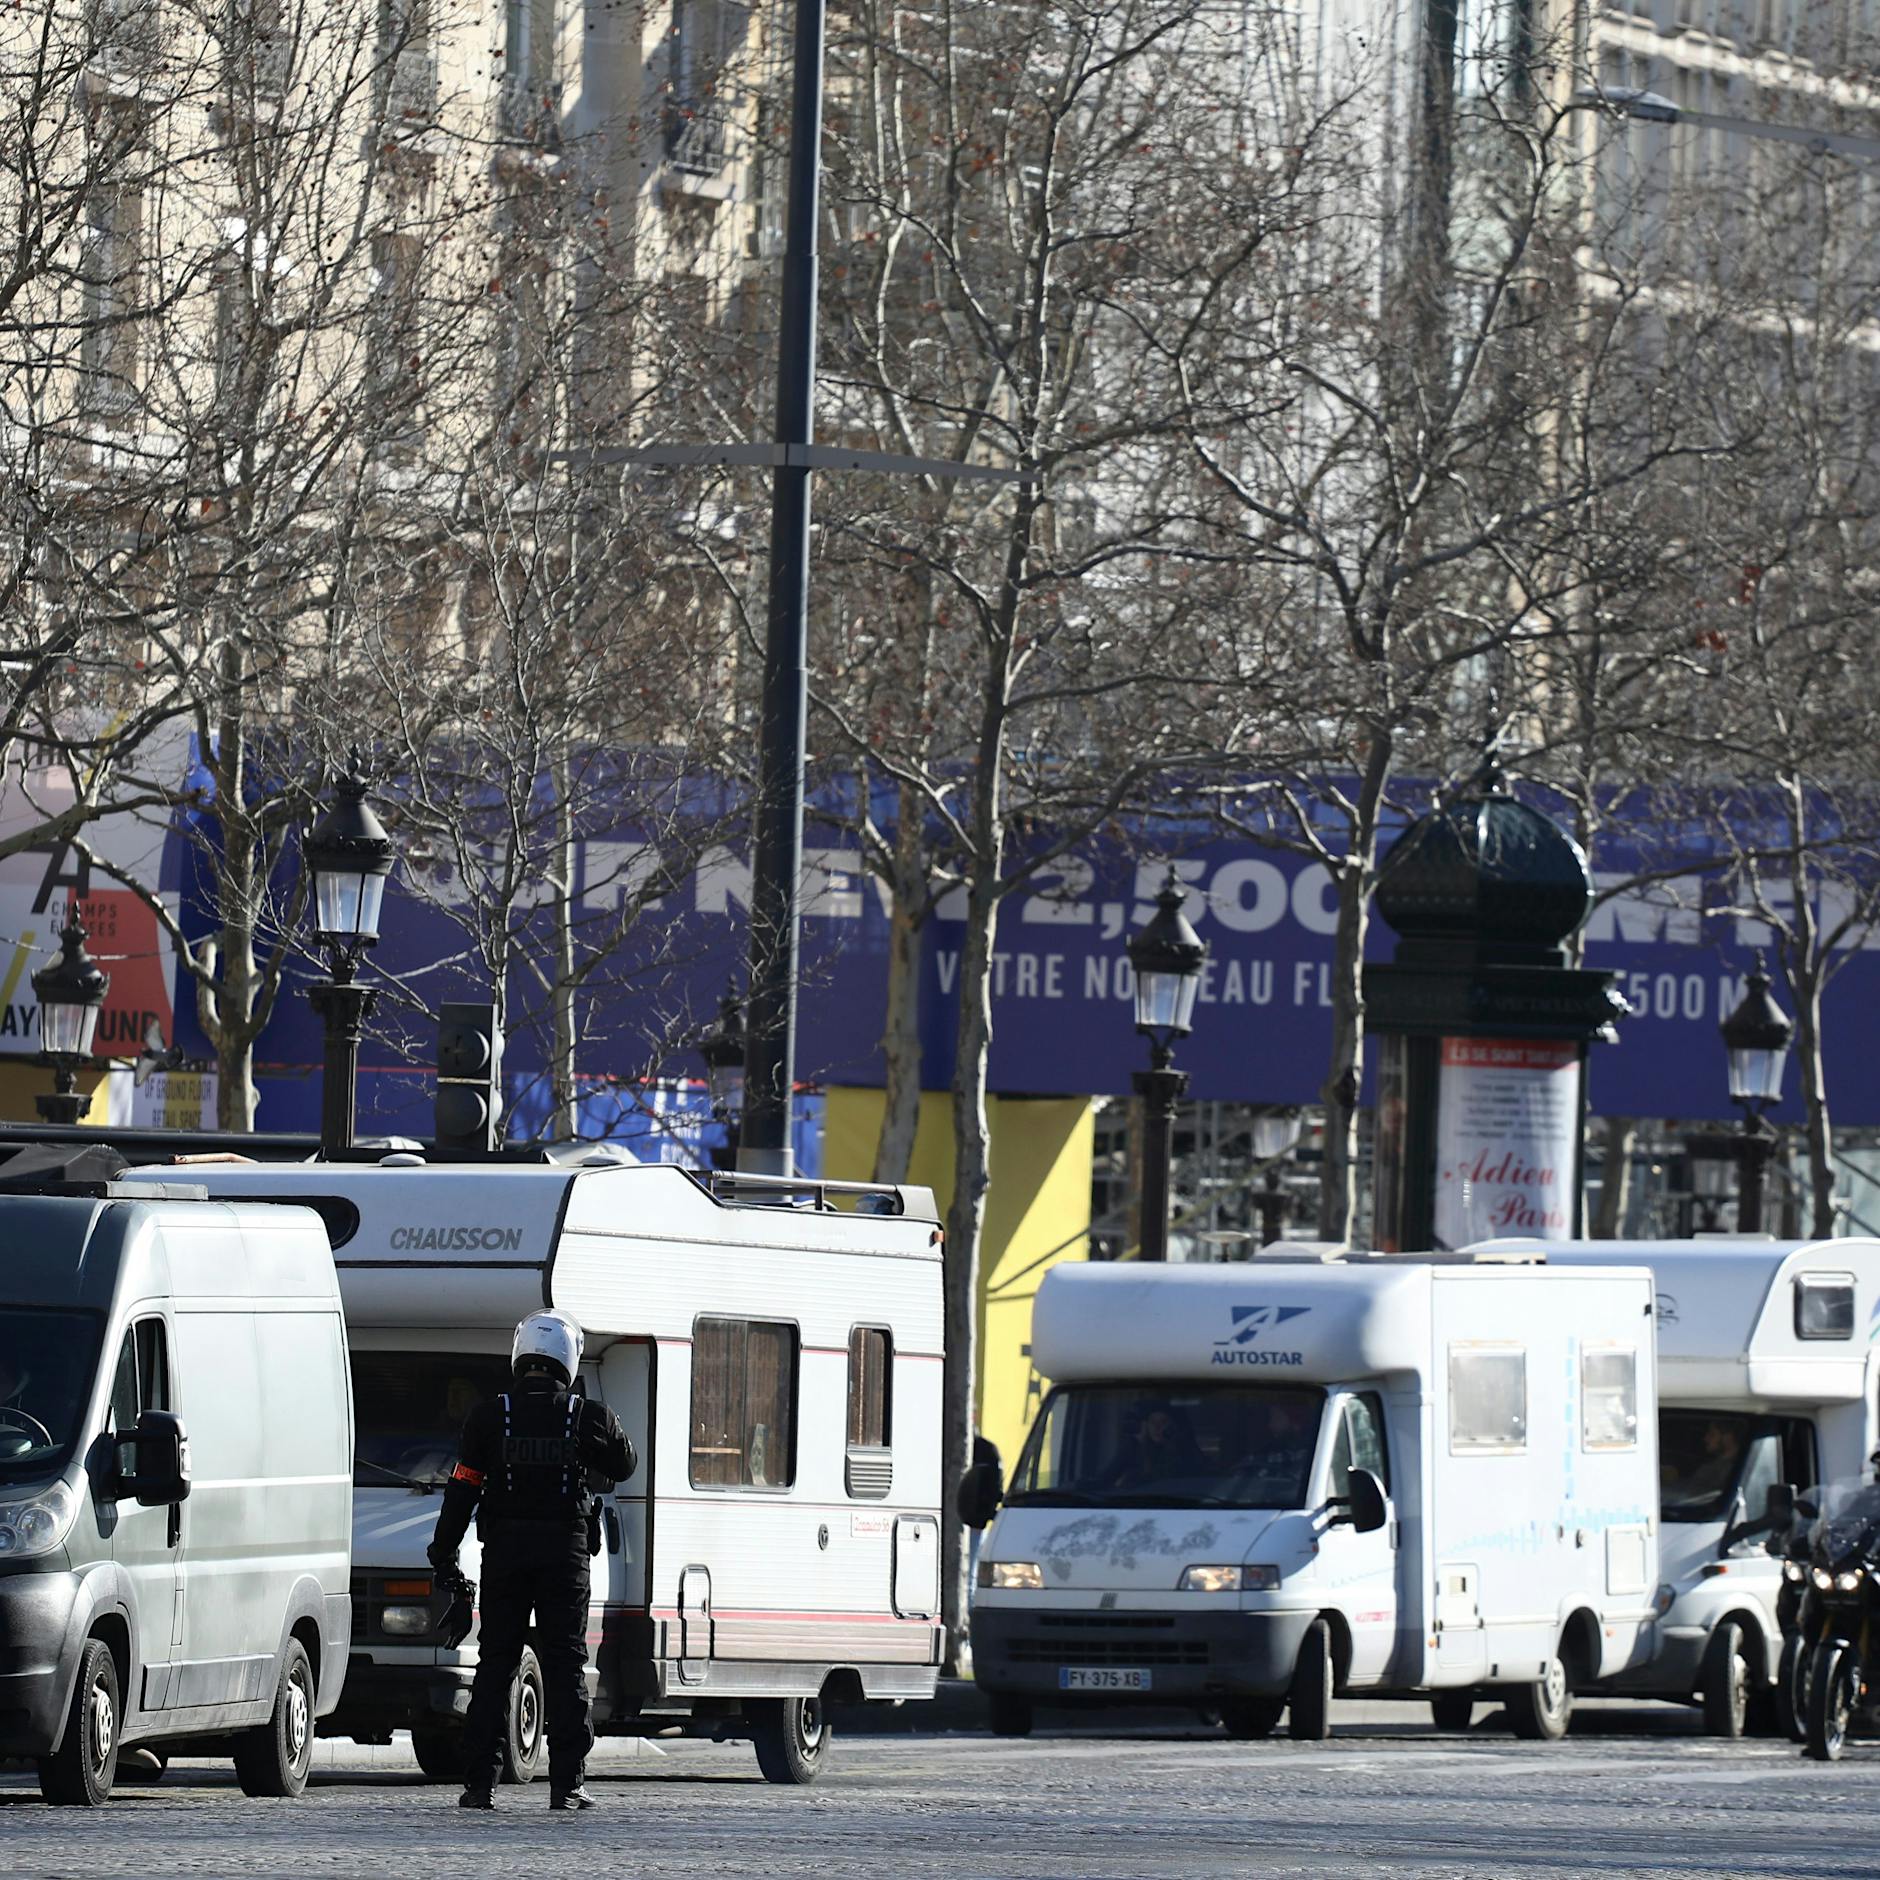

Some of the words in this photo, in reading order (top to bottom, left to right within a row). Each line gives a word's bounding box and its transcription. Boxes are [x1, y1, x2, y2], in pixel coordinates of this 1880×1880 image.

[397, 835, 666, 911] OUR
[51, 901, 117, 918] CHMPS
[936, 951, 1065, 998] VTRE
[1084, 955, 1274, 1004] NOEAU
[1, 1004, 162, 1043] AYUND
[389, 1227, 523, 1251] CHAUSSON
[1211, 1351, 1304, 1366] AUTOSTAR
